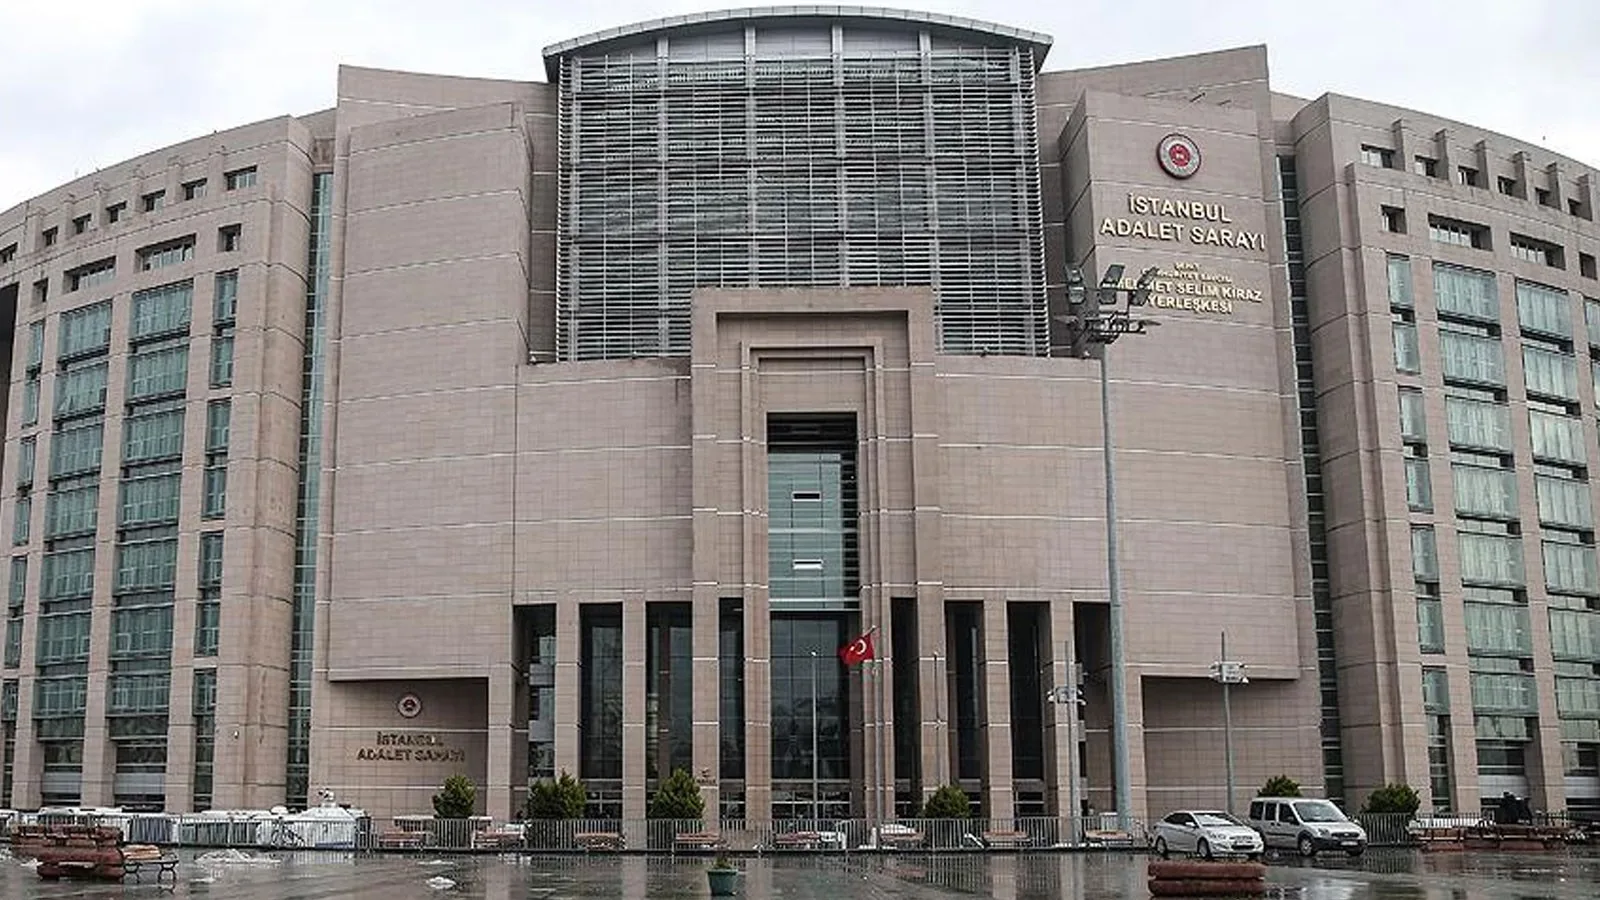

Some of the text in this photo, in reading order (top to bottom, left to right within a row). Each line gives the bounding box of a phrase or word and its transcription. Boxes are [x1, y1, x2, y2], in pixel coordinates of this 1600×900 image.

[1128, 193, 1232, 222] İSTANBUL
[1101, 218, 1265, 251] ADALET SARAYI
[356, 749, 411, 761] ADALET
